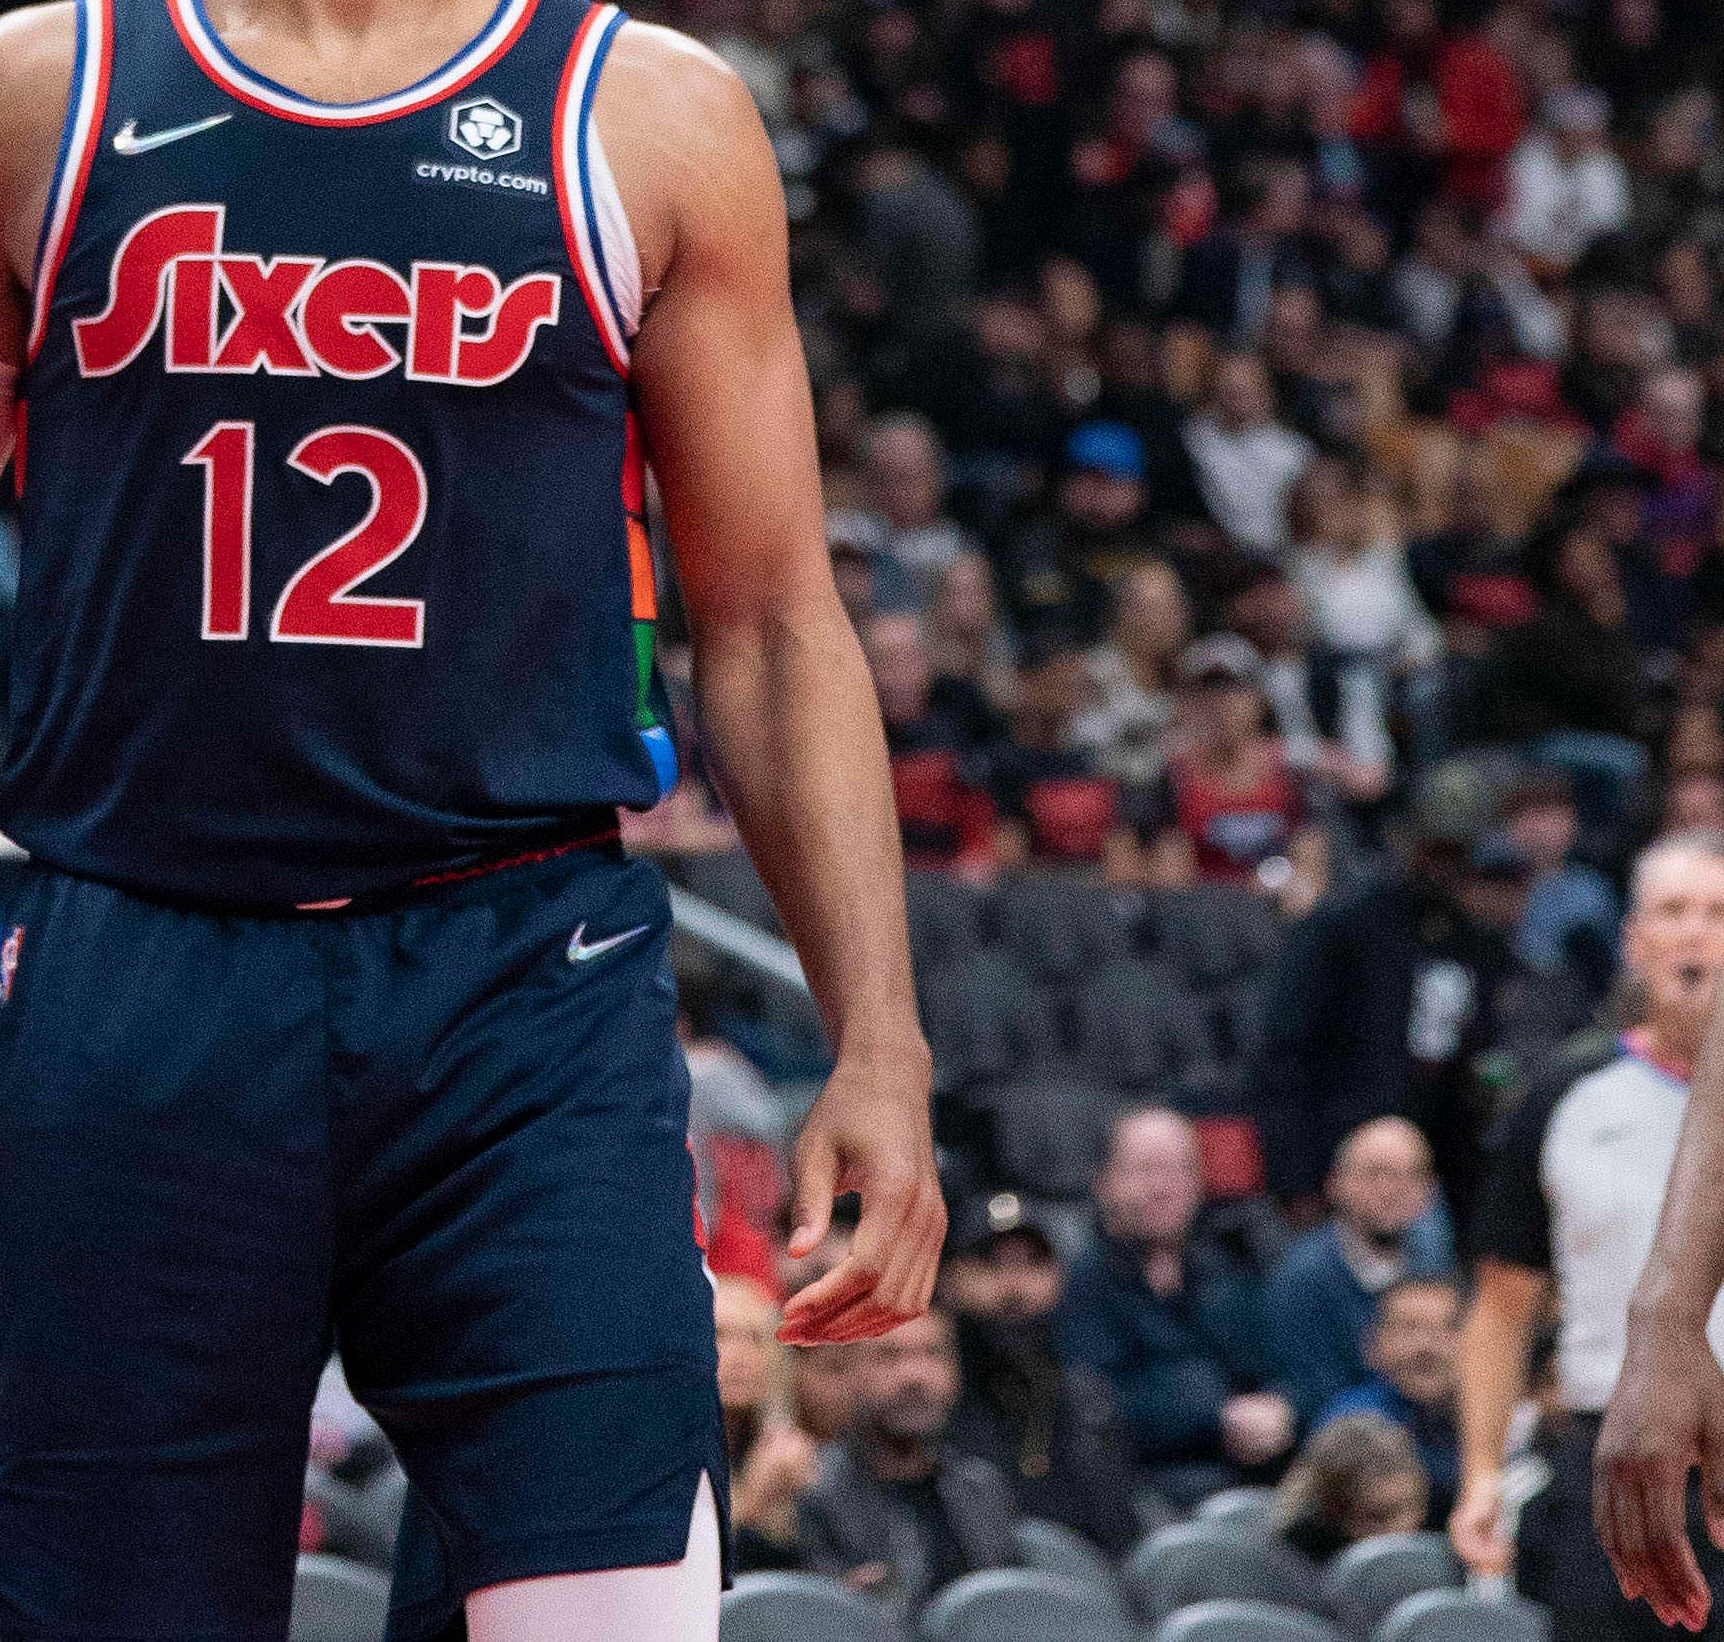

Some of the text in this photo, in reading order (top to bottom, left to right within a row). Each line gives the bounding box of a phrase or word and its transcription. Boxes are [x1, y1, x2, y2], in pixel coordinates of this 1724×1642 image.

[416, 163, 548, 195] crypto.com
[73, 204, 561, 387] Sixers
[180, 419, 428, 649] 12
